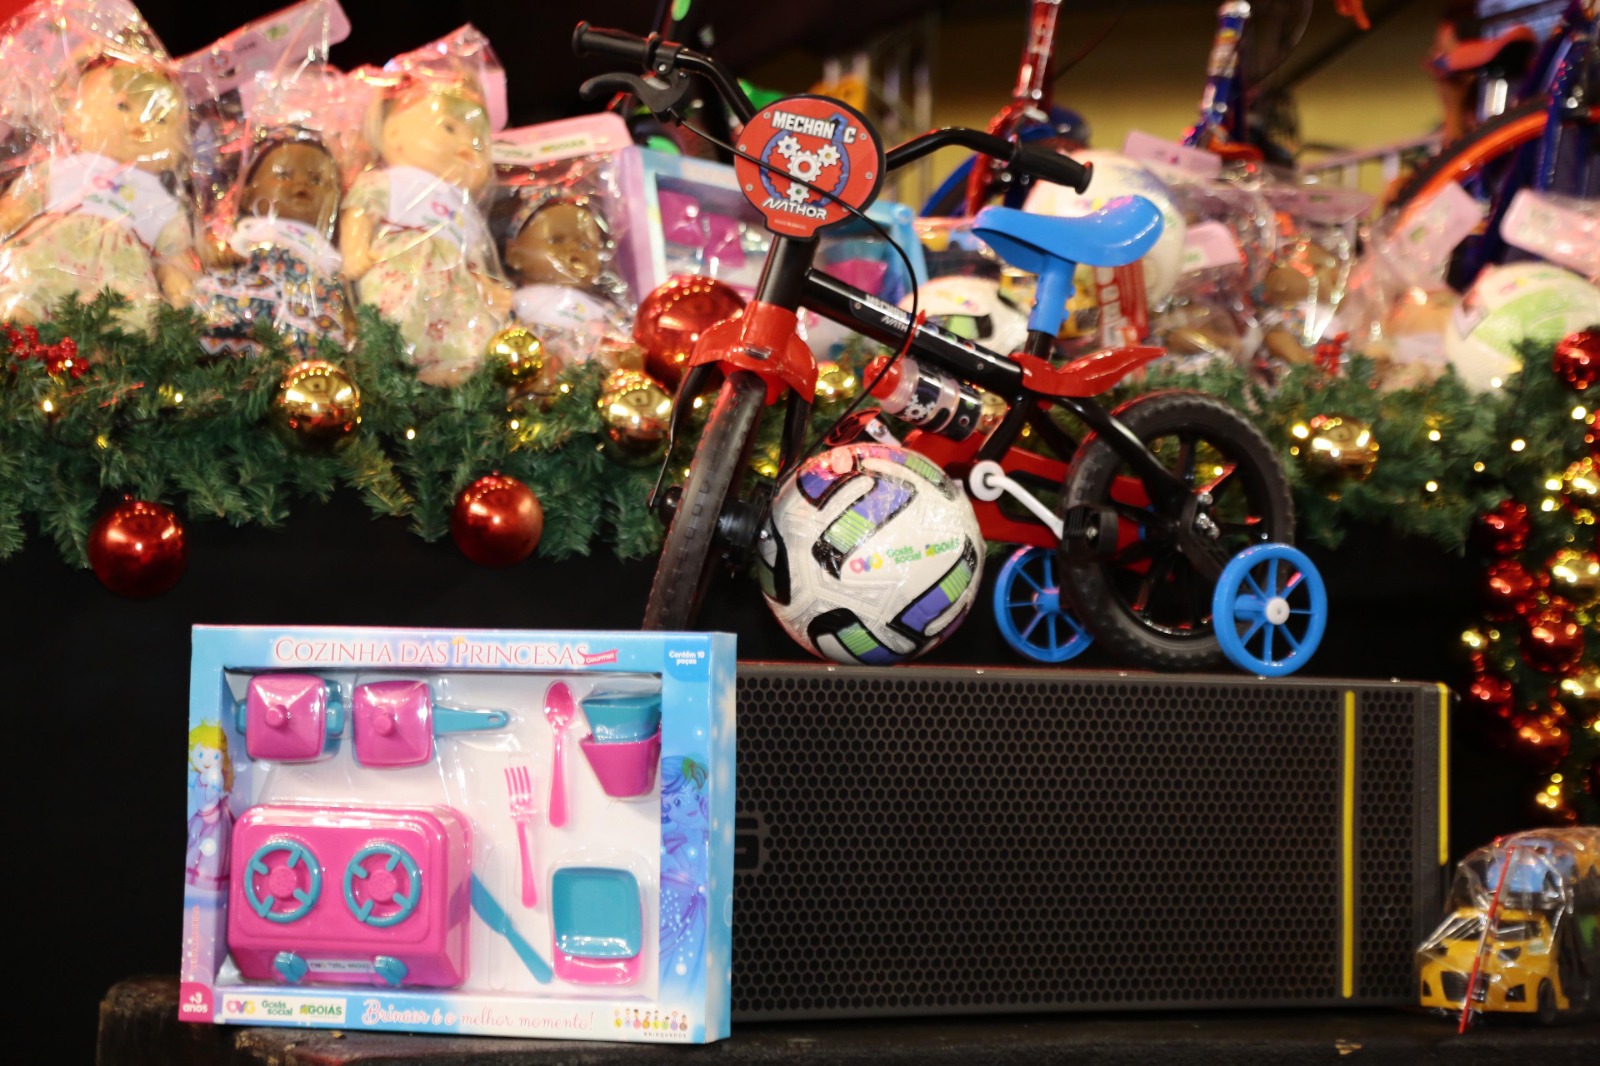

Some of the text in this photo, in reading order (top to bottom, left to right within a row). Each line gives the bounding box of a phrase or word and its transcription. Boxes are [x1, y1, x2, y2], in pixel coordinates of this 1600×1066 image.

[762, 197, 828, 220] NATHOR
[275, 637, 588, 666] COZINHA DAS PRINCESAS
[188, 991, 203, 1004] +3
[182, 1003, 209, 1014] anos
